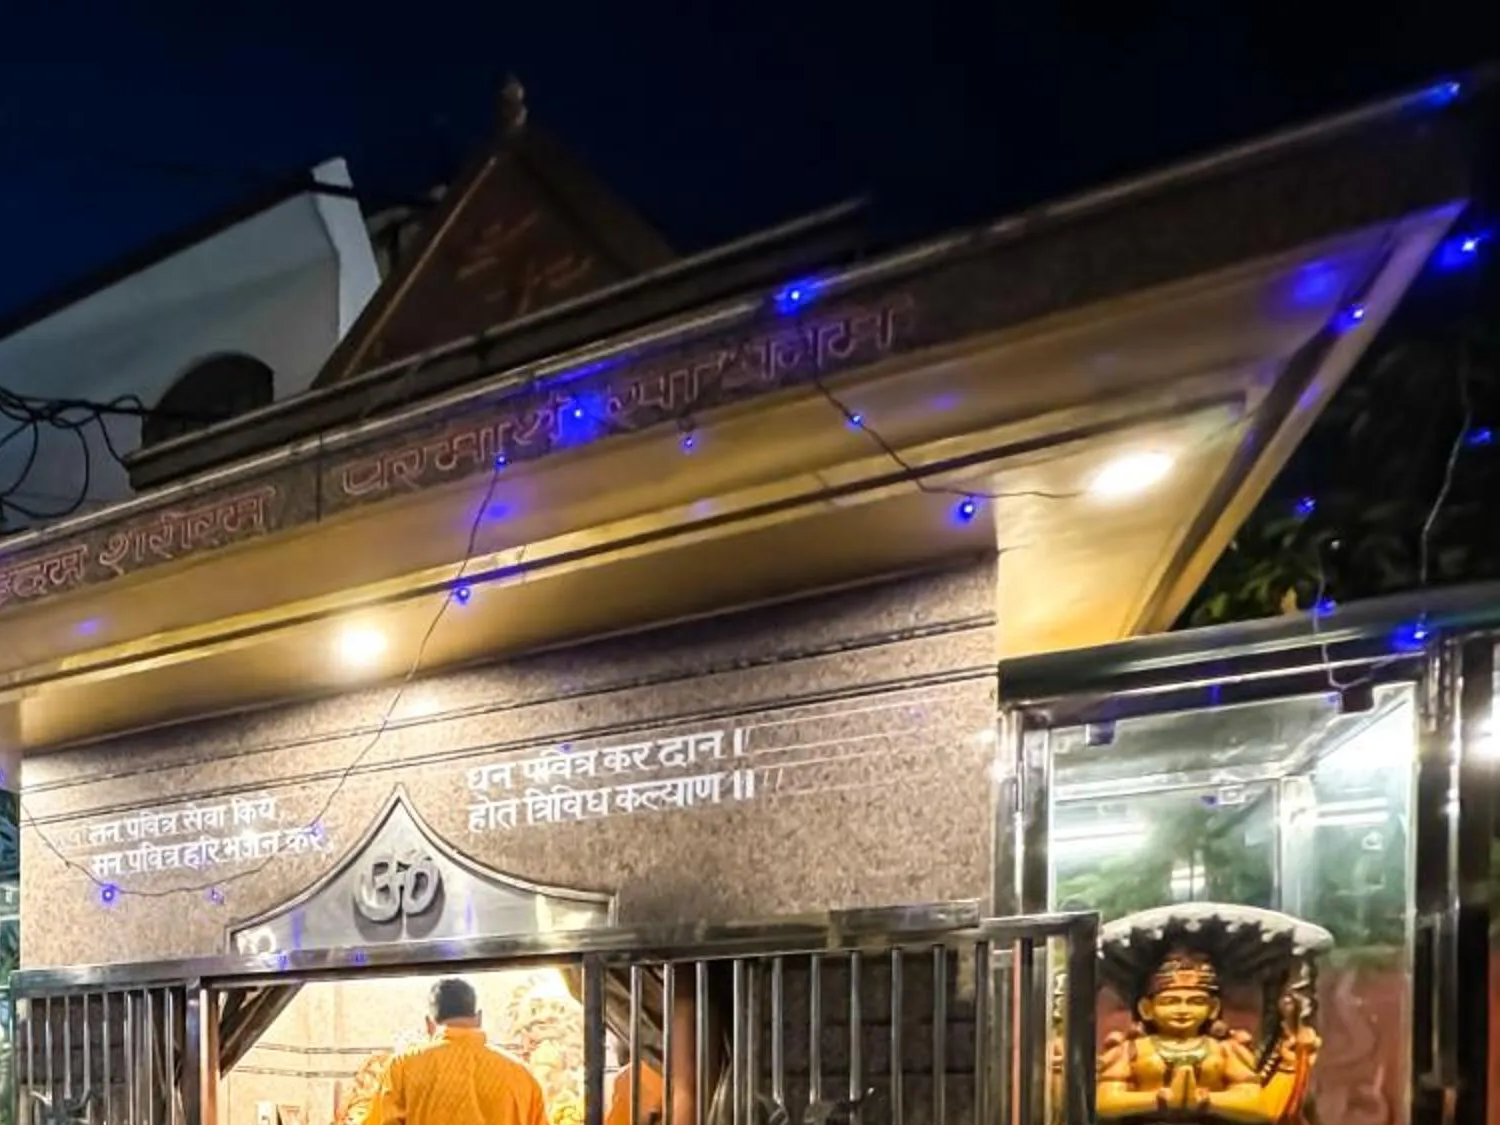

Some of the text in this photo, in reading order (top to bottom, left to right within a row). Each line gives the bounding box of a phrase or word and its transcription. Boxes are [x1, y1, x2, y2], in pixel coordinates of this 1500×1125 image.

[602, 745, 653, 772] कर
[656, 729, 726, 768] दान
[615, 771, 728, 812] कल्याण
